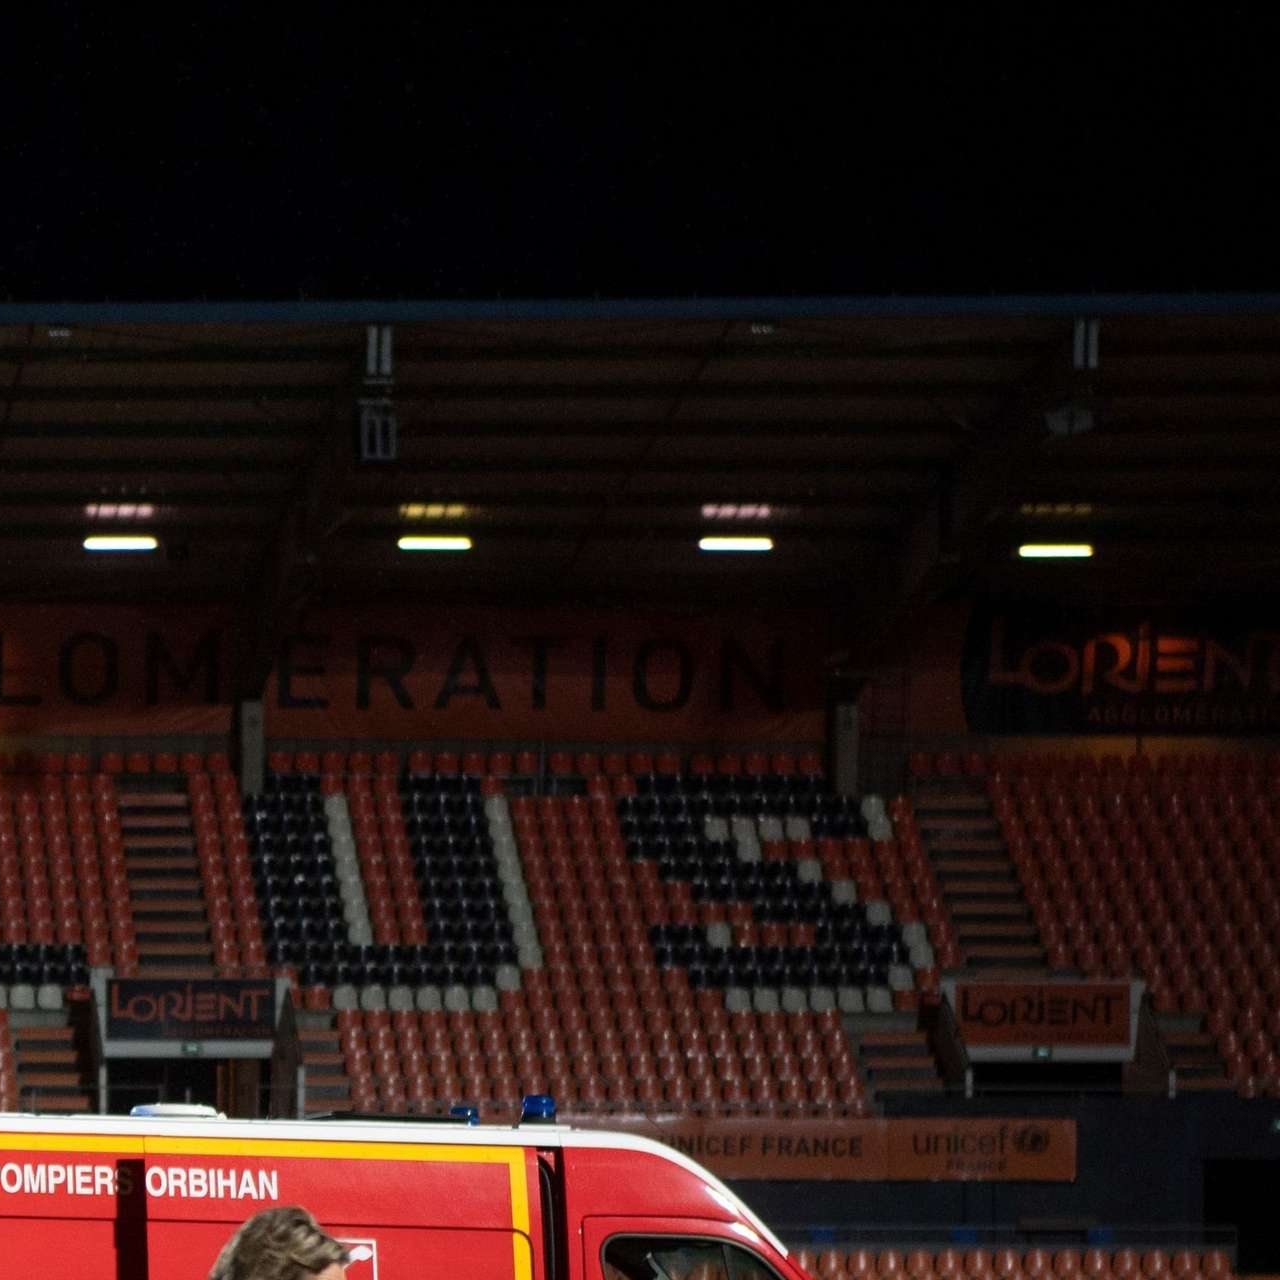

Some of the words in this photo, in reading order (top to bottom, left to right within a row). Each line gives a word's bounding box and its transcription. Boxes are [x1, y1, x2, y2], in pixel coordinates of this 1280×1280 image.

[111, 983, 271, 1022] LORIENT
[962, 989, 1124, 1026] LORIENT
[761, 1136, 864, 1158] FRANCE
[913, 1127, 1009, 1154] unicef
